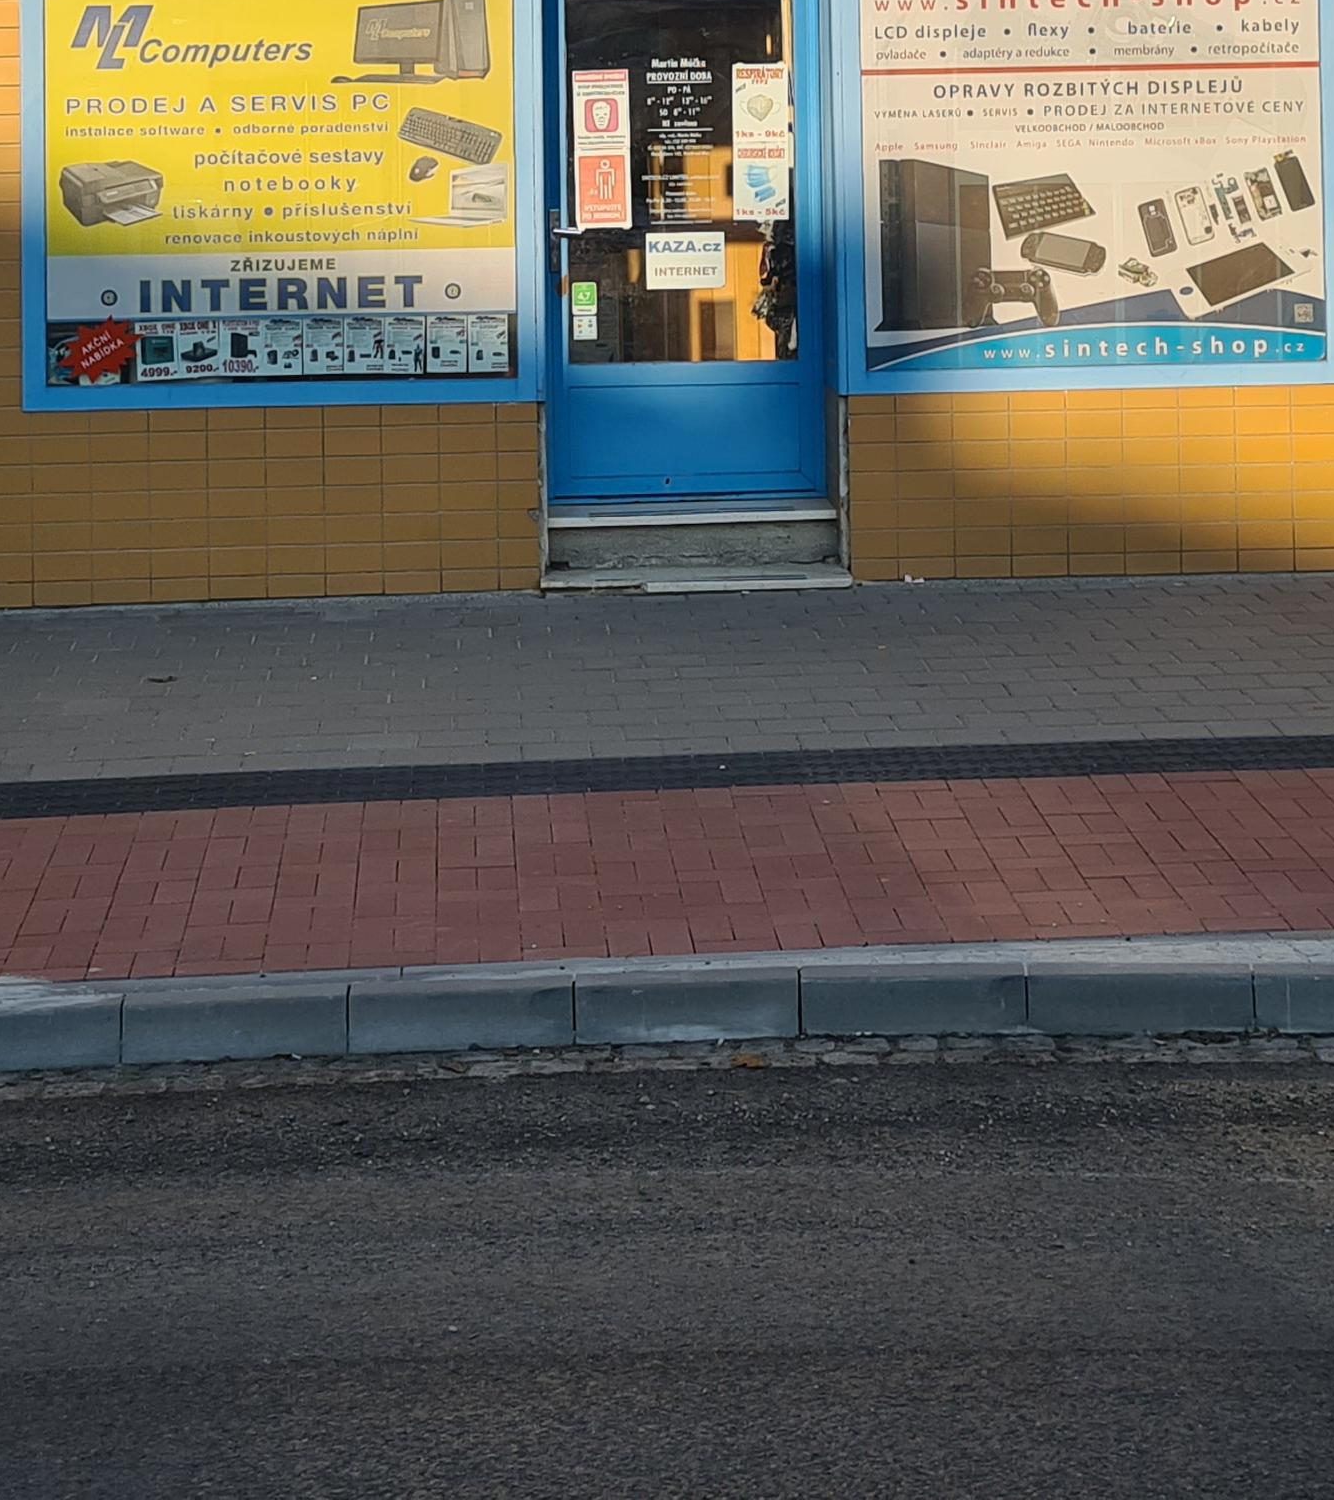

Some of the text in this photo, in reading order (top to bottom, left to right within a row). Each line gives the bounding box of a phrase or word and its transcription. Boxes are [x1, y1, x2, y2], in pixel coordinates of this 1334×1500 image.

[874, 18, 1300, 41] LCD displeje flexy baterie kabely
[138, 38, 313, 70] Computers
[1015, 49, 1023, 58] a
[1024, 46, 1070, 58] redukce
[1113, 43, 1175, 58] membrány
[1208, 41, 1300, 56] retropočítače
[646, 69, 713, 83] PROVOZNÍ DOBA
[933, 75, 1244, 99] OPRAVY ROZBITÝCH DISPLEJŮ
[66, 94, 391, 117] PRODEJ A SERVIS PC
[982, 107, 1018, 117] SERVIS
[1044, 102, 1107, 117] PRODEJ
[1114, 103, 1135, 116] ZA
[1141, 100, 1255, 116] INTERNETOVÉ
[1262, 100, 1305, 113] CENY
[65, 125, 134, 137] instalace
[139, 124, 205, 137] software
[1015, 121, 1165, 133] VELKOOBCHOD MALOOBCHOD
[875, 142, 904, 152] Apple
[913, 141, 958, 152] Samsung
[1017, 139, 1048, 150] Amiga
[1056, 139, 1082, 148] SEGA
[1089, 137, 1135, 148] Nintendo
[1144, 136, 1192, 147] Microsoft
[1225, 135, 1249, 147] Sony
[194, 147, 385, 169] počítačové sestavy
[223, 175, 357, 193] notebooky
[173, 200, 413, 221] tiskárny příslušenství
[165, 226, 420, 246] renovace inkoustových náplní
[648, 240, 722, 254] KAZA.cz
[230, 255, 337, 273] ZŘIZUJEME
[654, 266, 719, 277] INTERNET
[139, 274, 424, 315] INTERNET
[80, 330, 113, 355] AKČNÍ
[984, 336, 1306, 360] www.sintech-shop.cz
[80, 337, 124, 369] NABÍDKA
